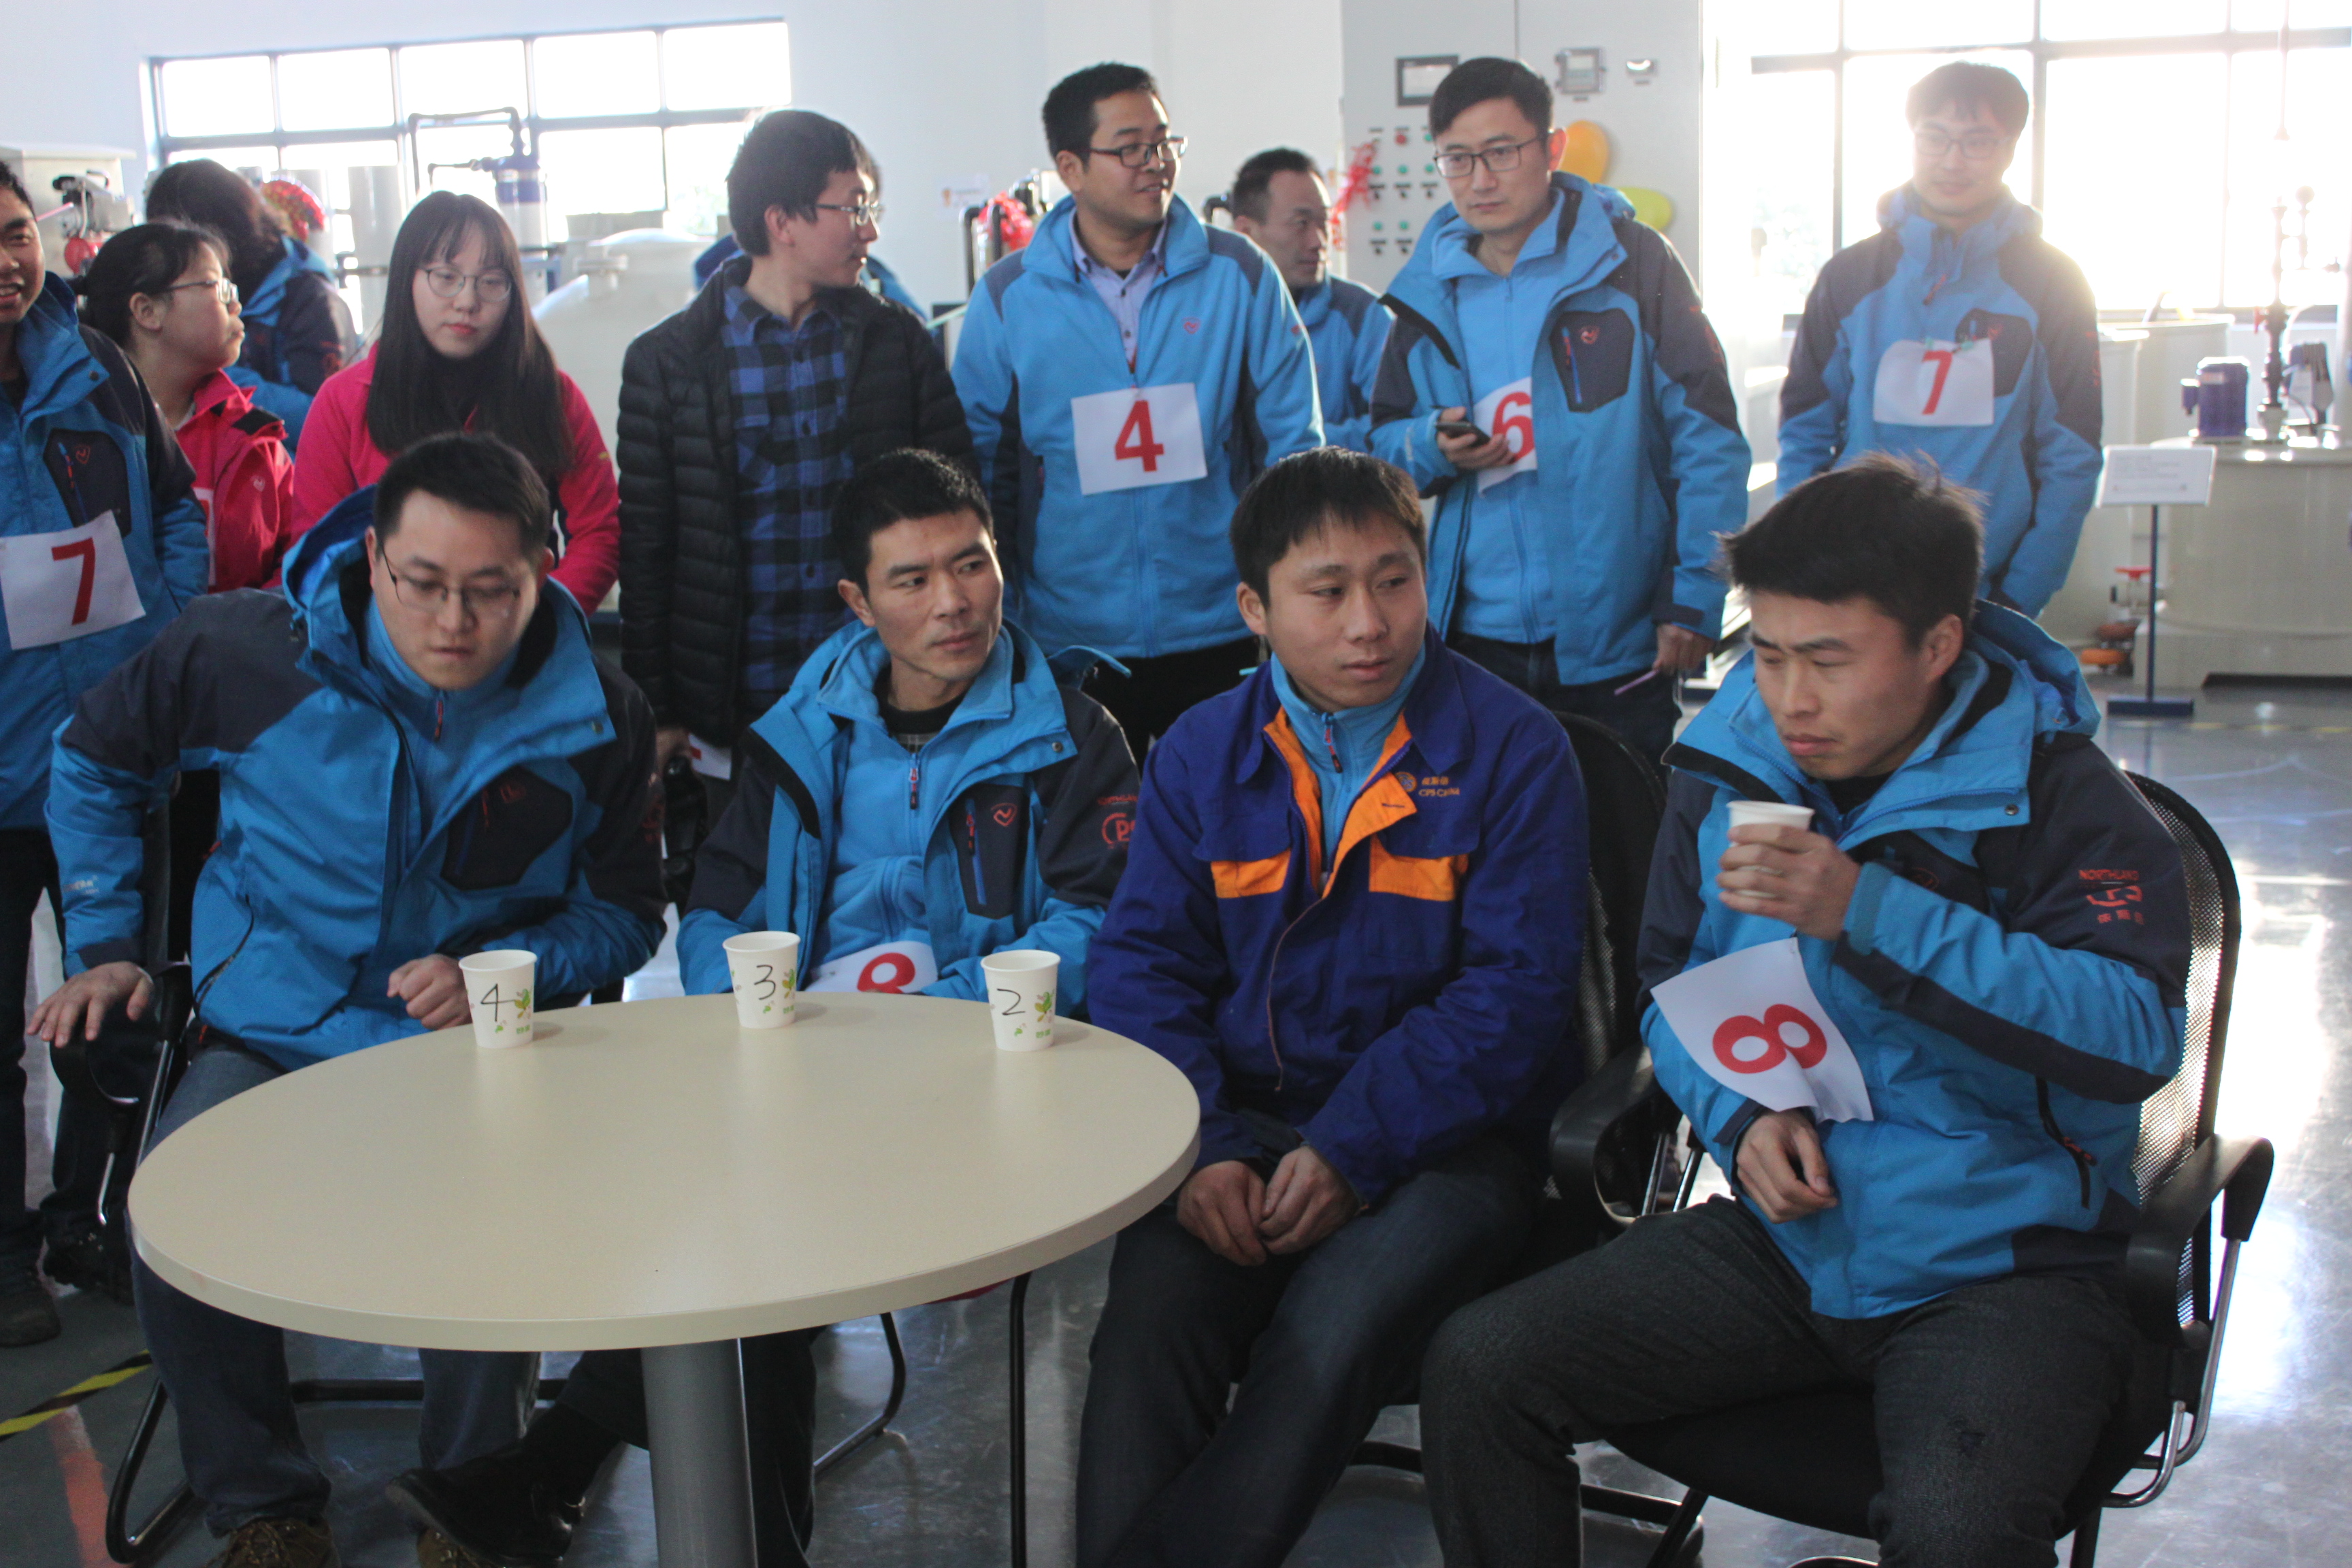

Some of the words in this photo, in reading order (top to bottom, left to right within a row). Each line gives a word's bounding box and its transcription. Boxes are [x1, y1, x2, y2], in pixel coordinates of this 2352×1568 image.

[1921, 349, 1953, 415] 7
[1114, 399, 1164, 472] 4
[1492, 391, 1535, 465] 6
[51, 537, 96, 626] 7
[480, 983, 516, 1022] 4
[753, 964, 776, 1000] 3
[996, 987, 1026, 1015] 2
[1712, 1003, 1827, 1074] 8
